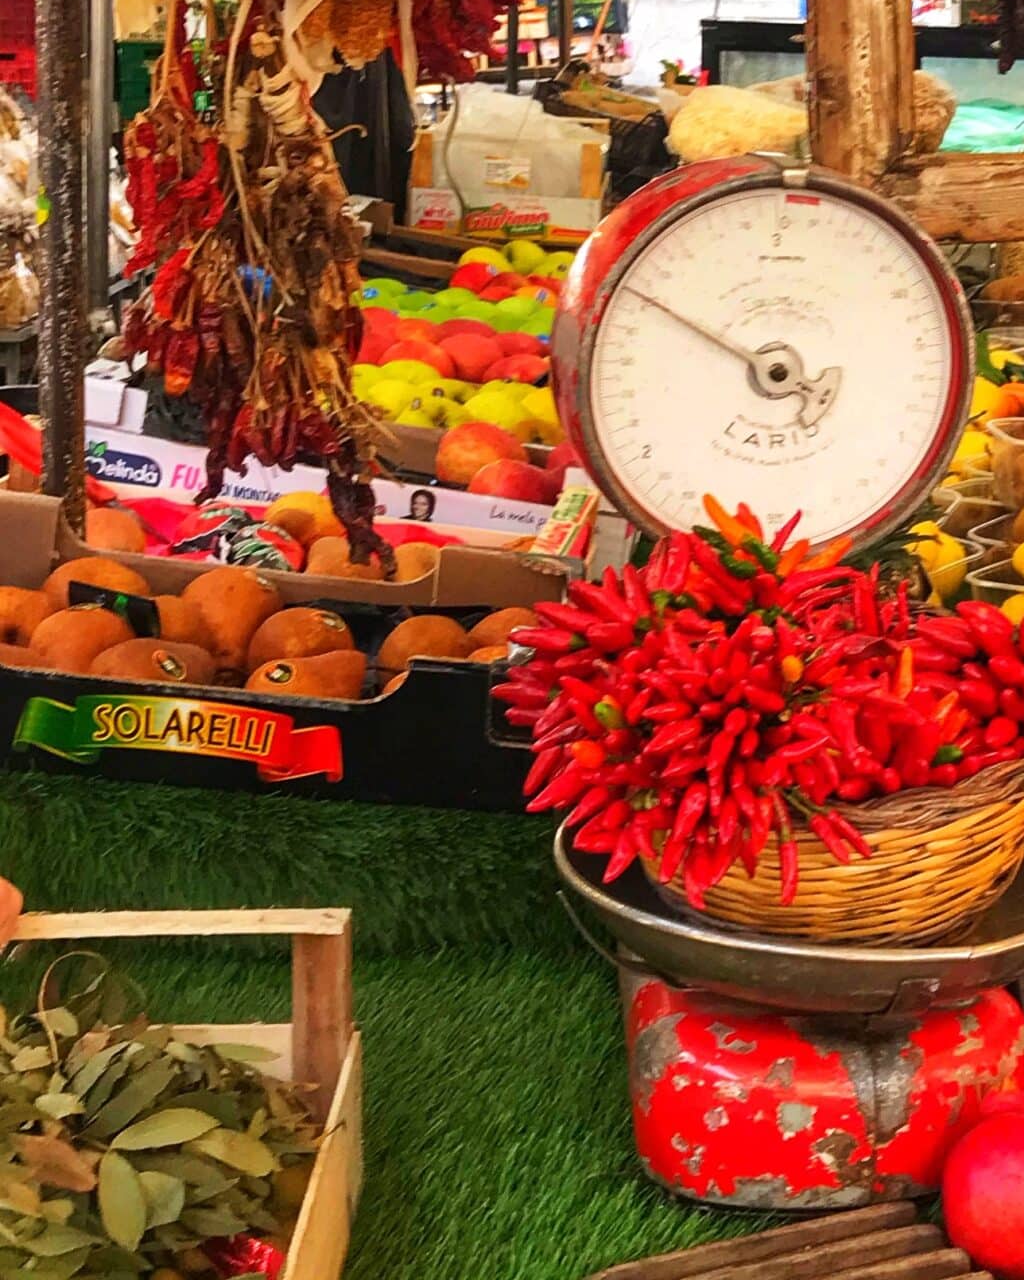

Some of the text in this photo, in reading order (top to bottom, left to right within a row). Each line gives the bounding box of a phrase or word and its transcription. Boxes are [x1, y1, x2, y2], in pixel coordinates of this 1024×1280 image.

[771, 233, 783, 247] 3
[641, 443, 653, 459] 2
[92, 703, 276, 756] SOLARELLI
